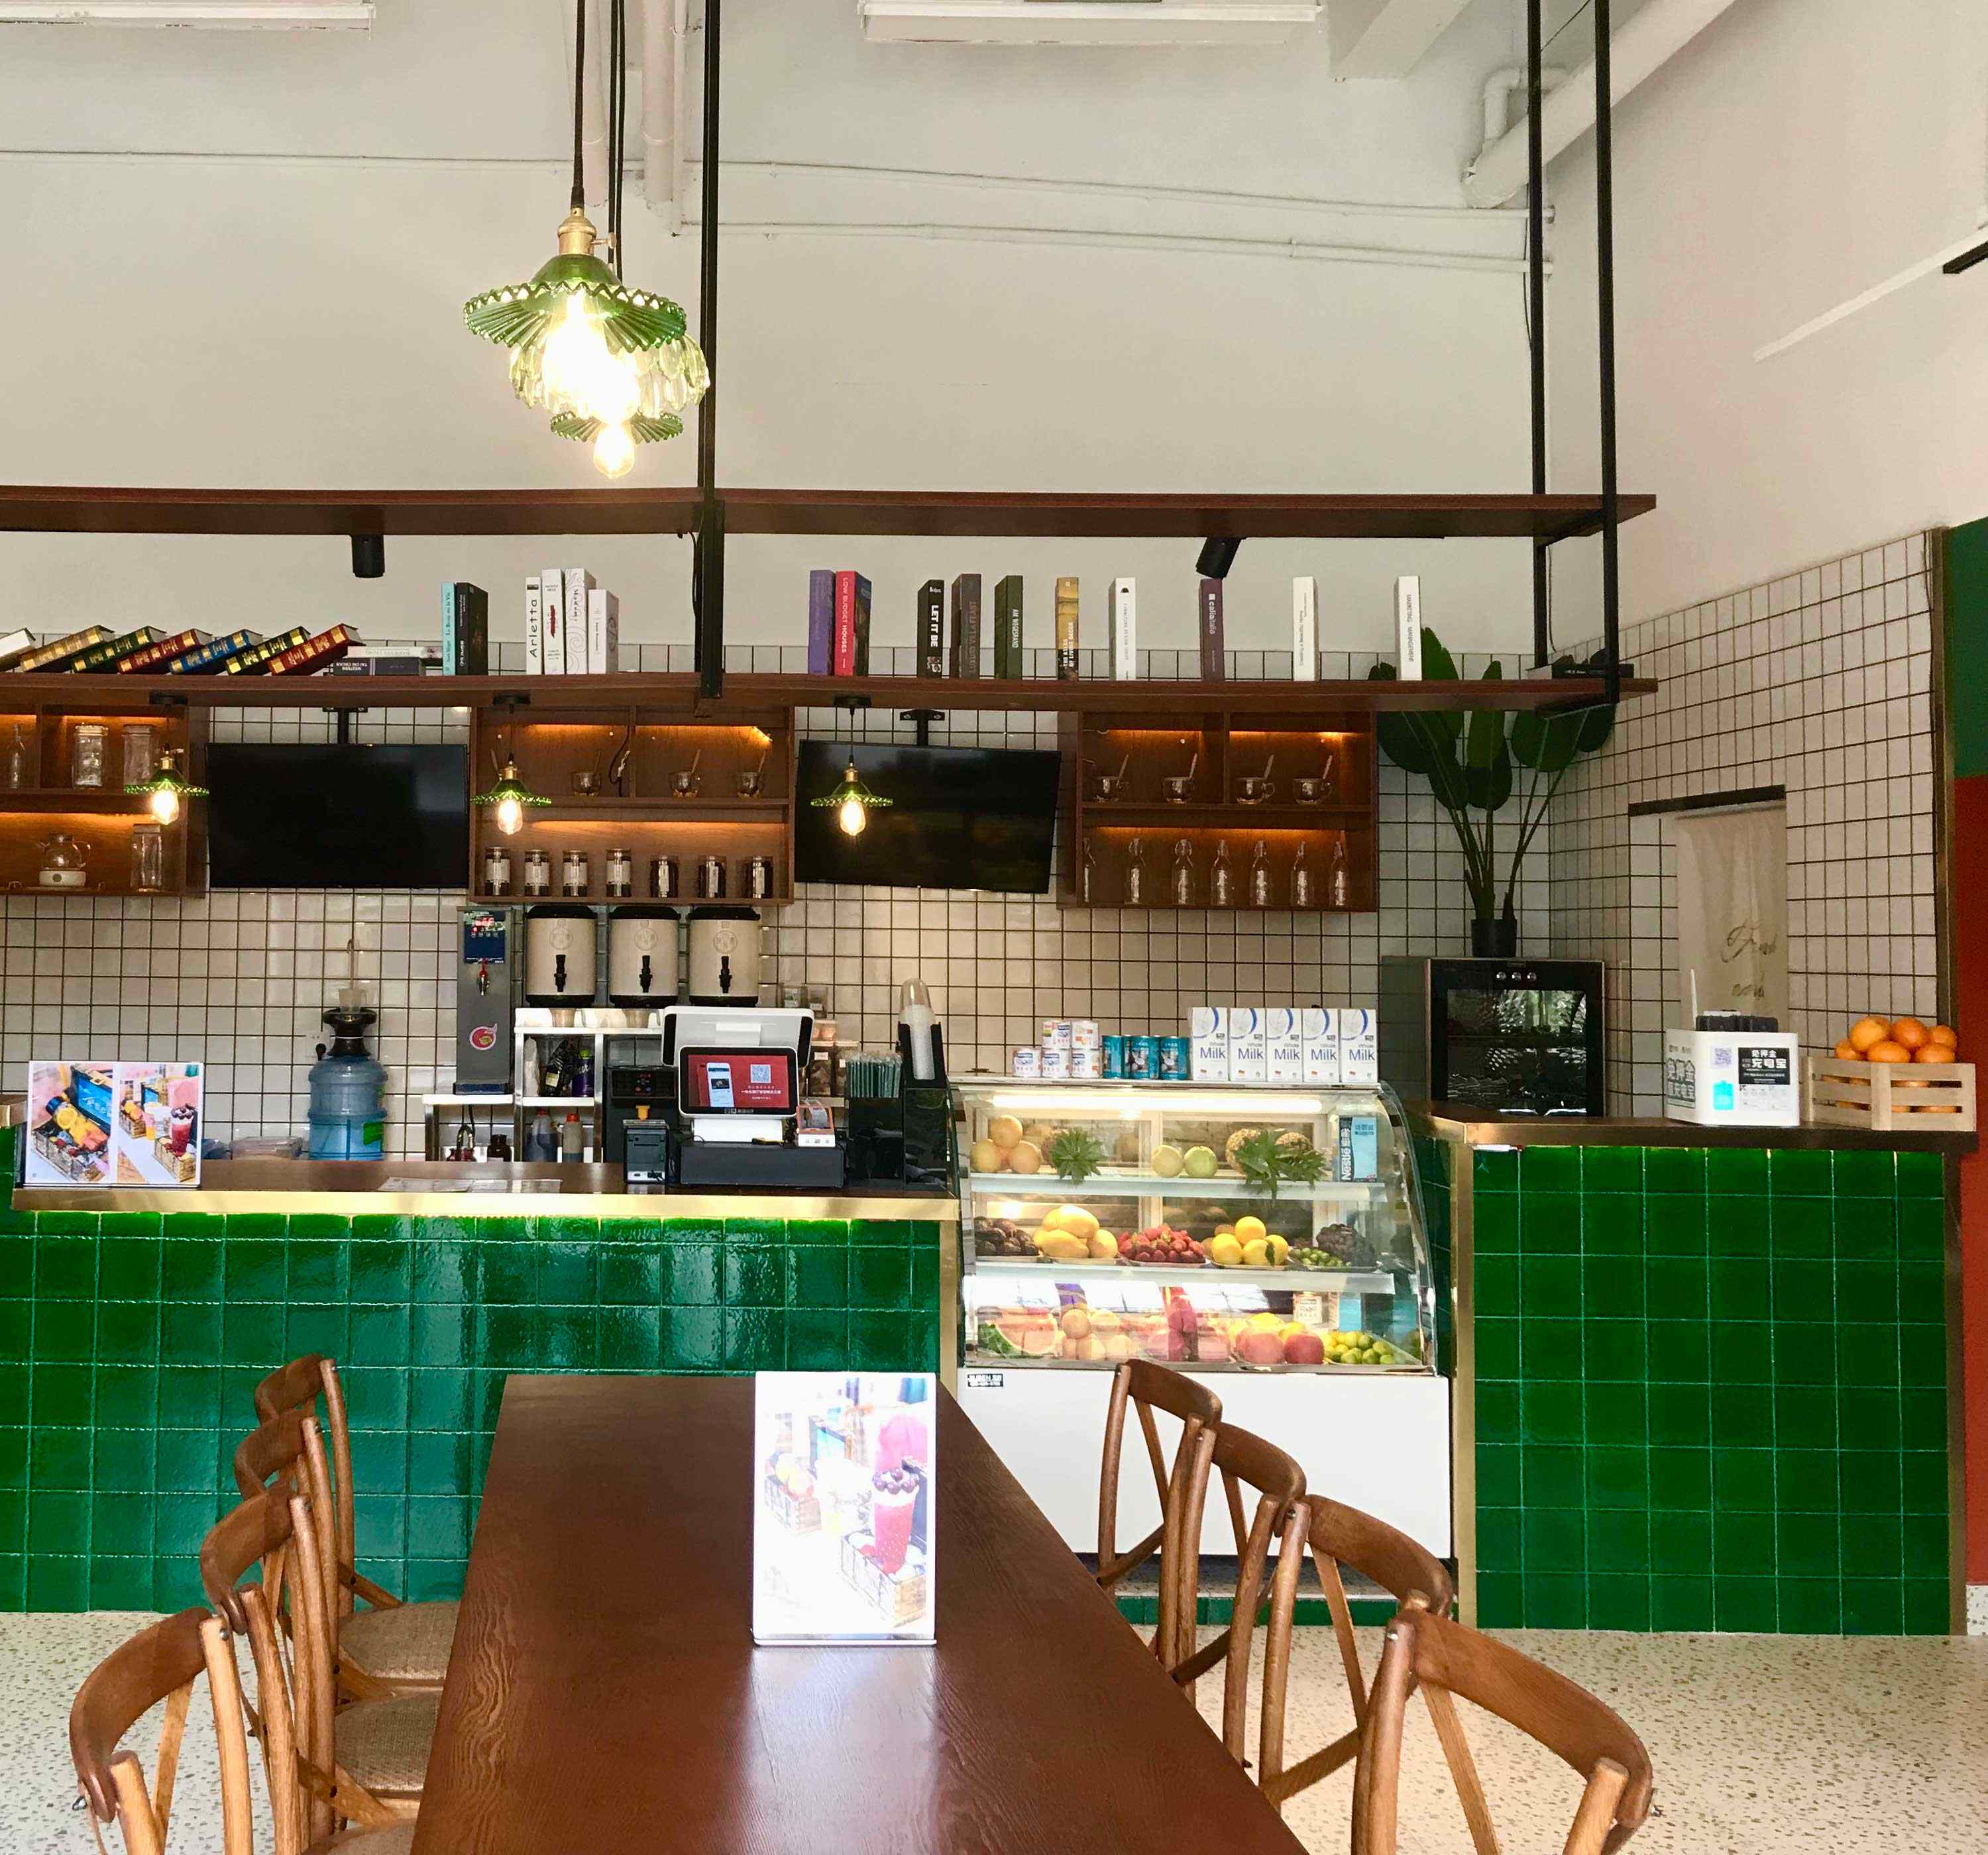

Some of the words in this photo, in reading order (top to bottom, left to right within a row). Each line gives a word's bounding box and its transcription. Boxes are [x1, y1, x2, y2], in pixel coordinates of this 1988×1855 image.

[930, 604, 939, 622] LET
[529, 599, 537, 658] Arletta
[930, 623, 938, 633] IT
[930, 635, 938, 647] BE
[1200, 1047, 1226, 1059] Milk
[1238, 1048, 1264, 1059] Milk
[1274, 1048, 1300, 1060] Milk
[1311, 1049, 1337, 1060] Milk
[1349, 1049, 1375, 1060] Milk
[1751, 1049, 1777, 1058] 免押金
[1751, 1058, 1787, 1069] 充电宝
